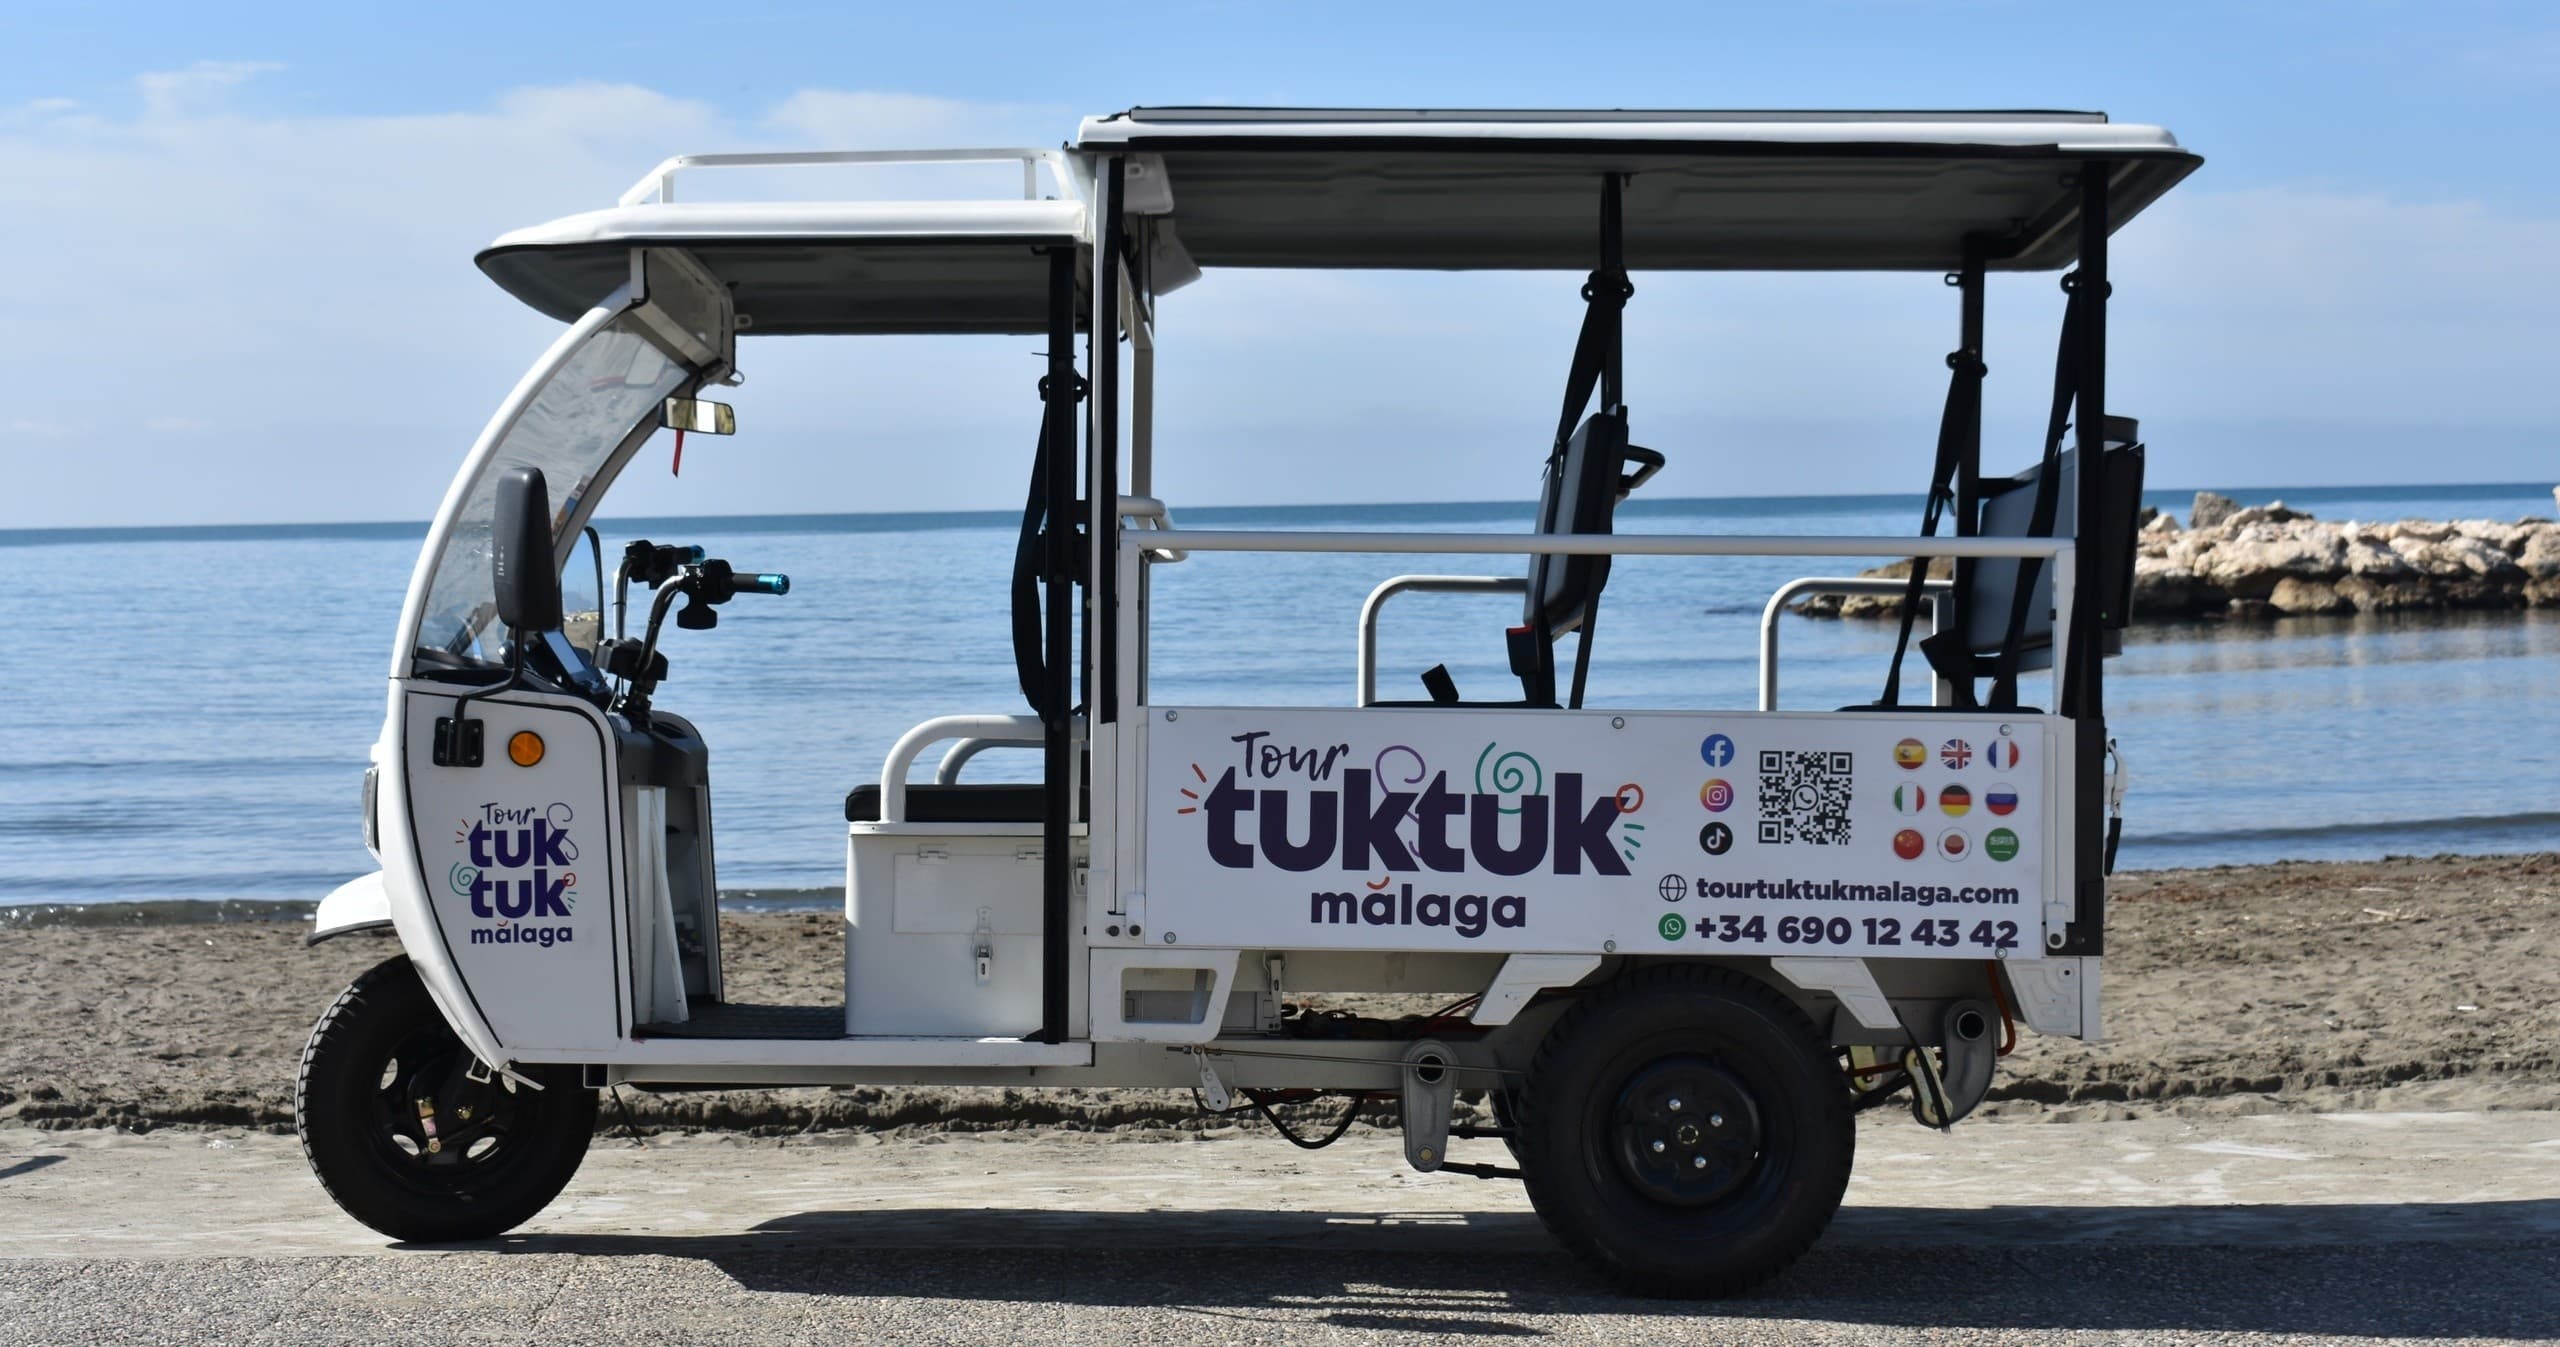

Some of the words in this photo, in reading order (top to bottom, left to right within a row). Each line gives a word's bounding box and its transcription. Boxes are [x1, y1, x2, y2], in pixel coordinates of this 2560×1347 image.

[1231, 730, 1349, 782] Tour
[480, 802, 536, 825] Tour
[468, 818, 571, 868] tuk
[469, 868, 572, 918] tuk
[1696, 878, 2020, 906] tourtuktukmalaga.com
[1695, 914, 1768, 944] +34
[1777, 916, 1852, 945] 690
[1862, 917, 1901, 946] 12
[1910, 918, 1960, 948] 43
[1969, 919, 2019, 949] 42
